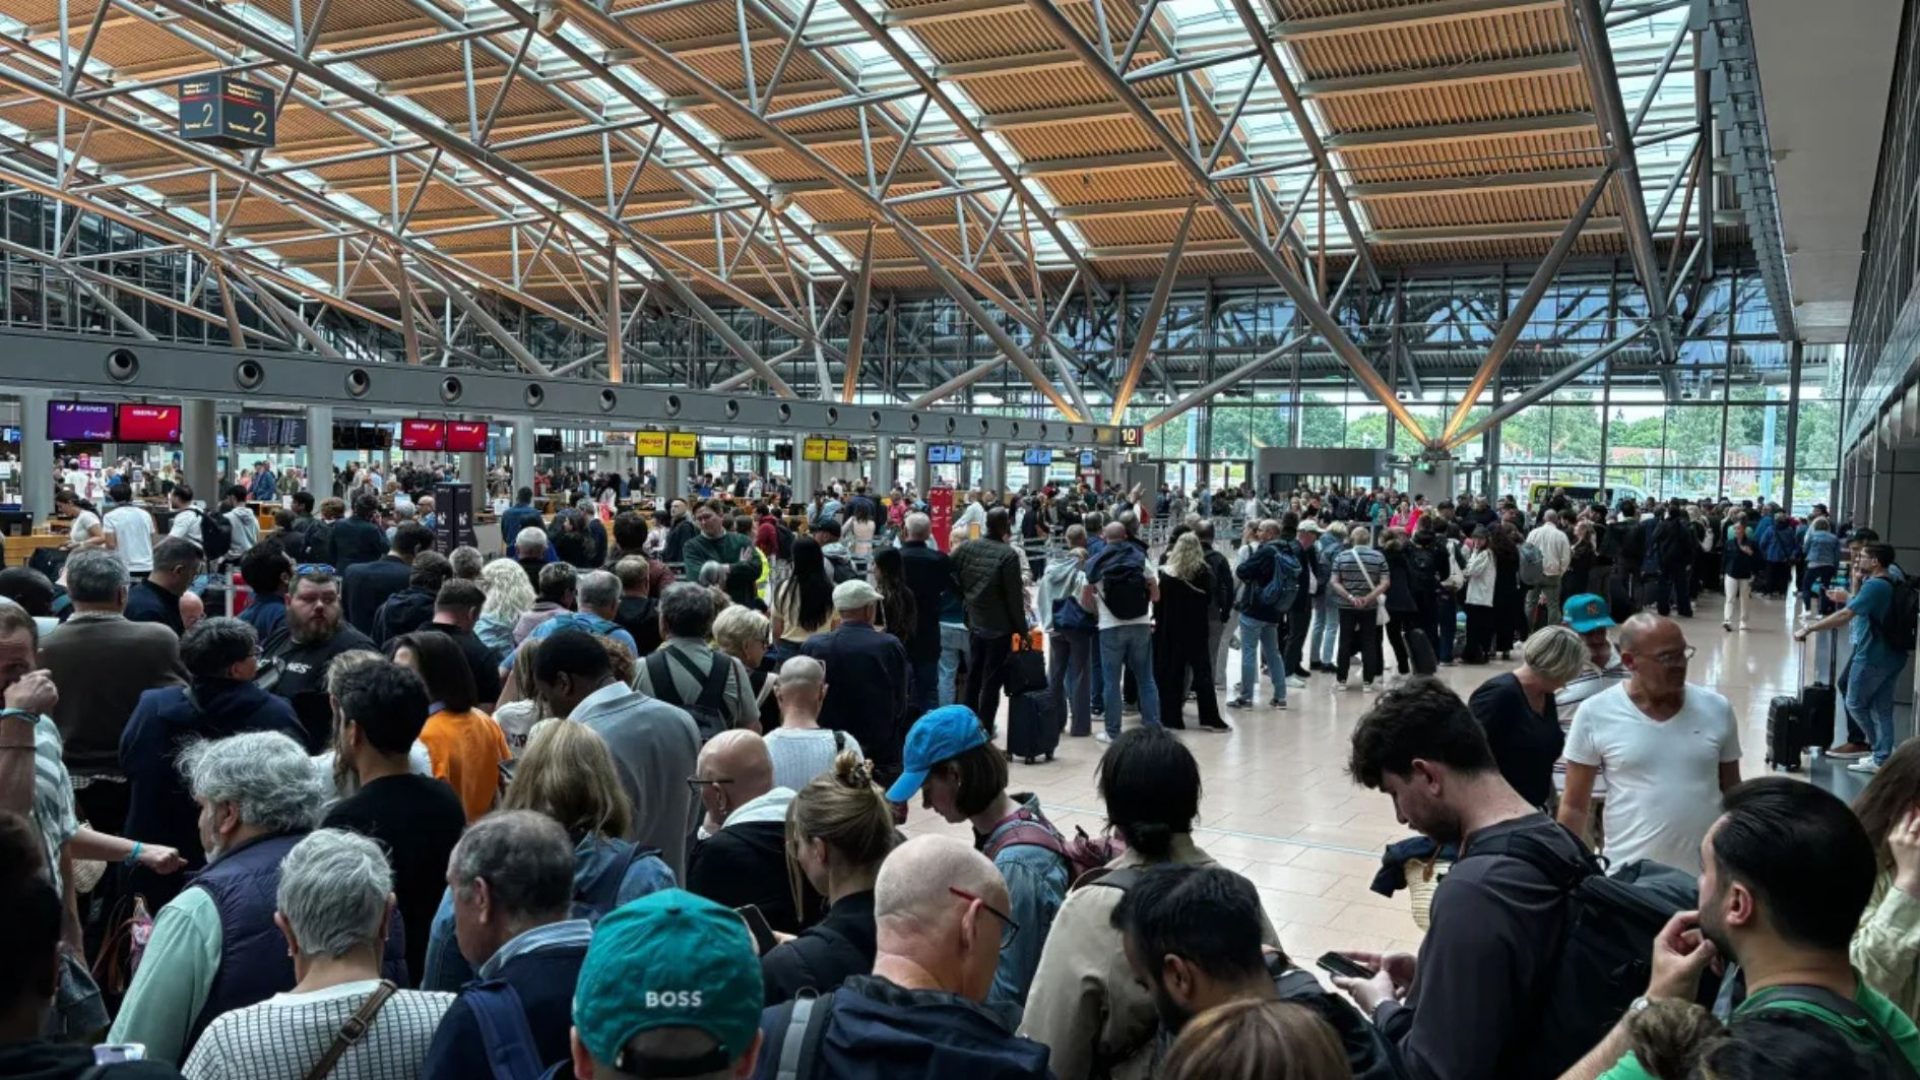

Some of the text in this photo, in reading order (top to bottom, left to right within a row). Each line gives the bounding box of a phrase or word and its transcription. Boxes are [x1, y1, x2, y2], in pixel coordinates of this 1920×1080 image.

[202, 103, 213, 127] 2
[253, 111, 267, 136] 2
[1121, 428, 1136, 441] 10
[645, 990, 703, 1009] BOSS
